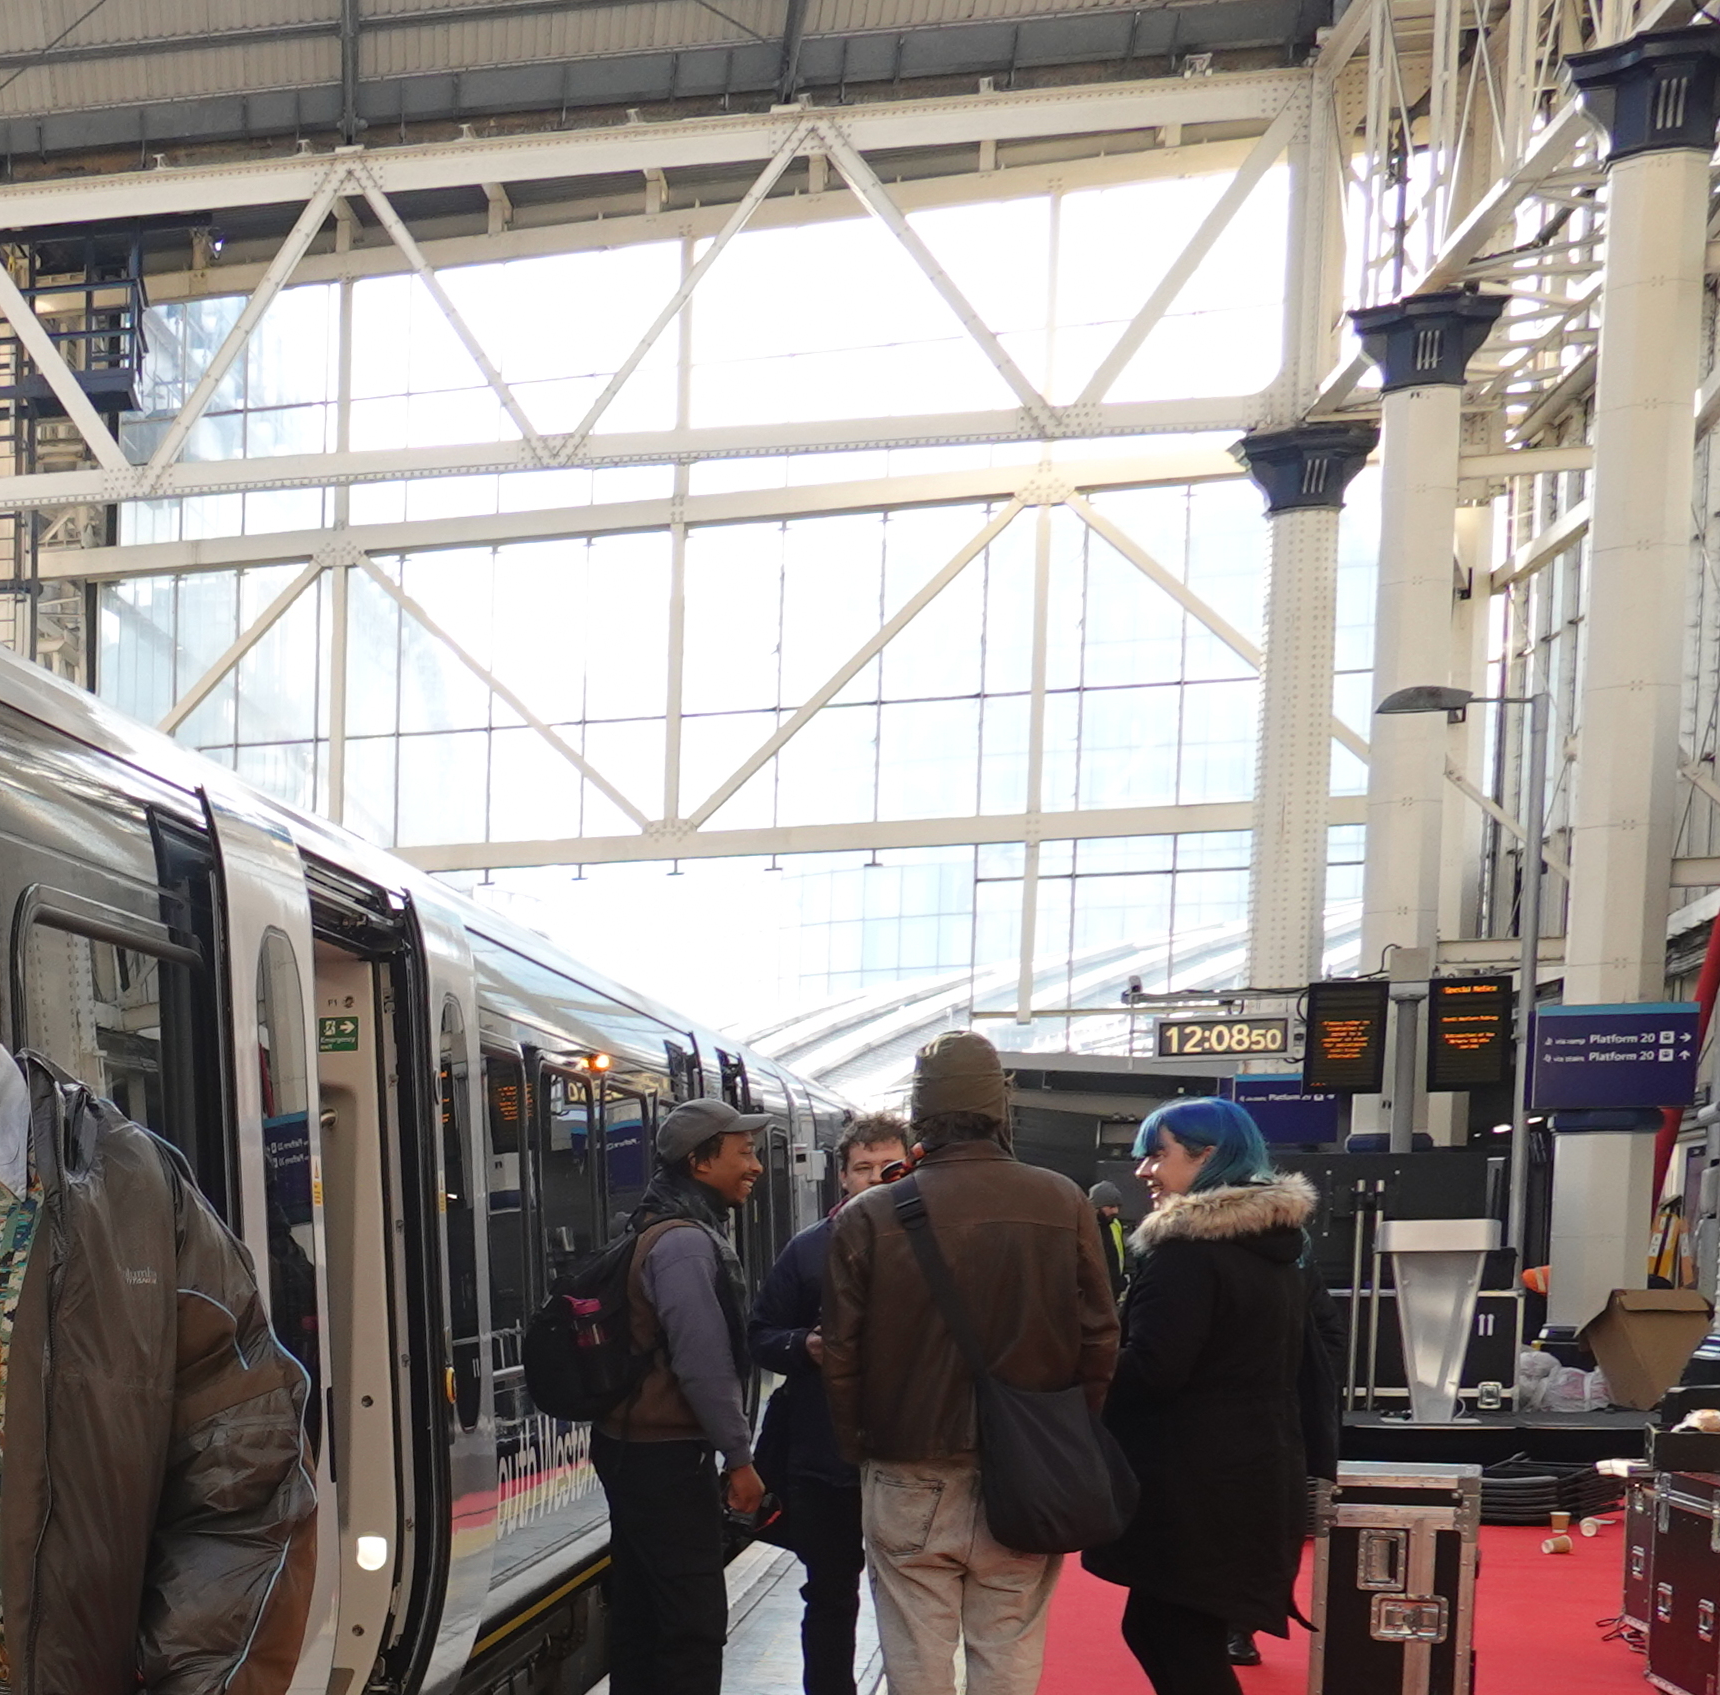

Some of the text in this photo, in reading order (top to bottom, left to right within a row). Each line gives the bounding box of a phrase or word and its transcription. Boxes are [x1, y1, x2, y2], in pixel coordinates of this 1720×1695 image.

[1590, 1033, 1638, 1044] Platform
[1640, 1033, 1656, 1043] 20
[1589, 1051, 1637, 1062] Platform
[1639, 1051, 1655, 1061] 20
[497, 1418, 538, 1540] outh
